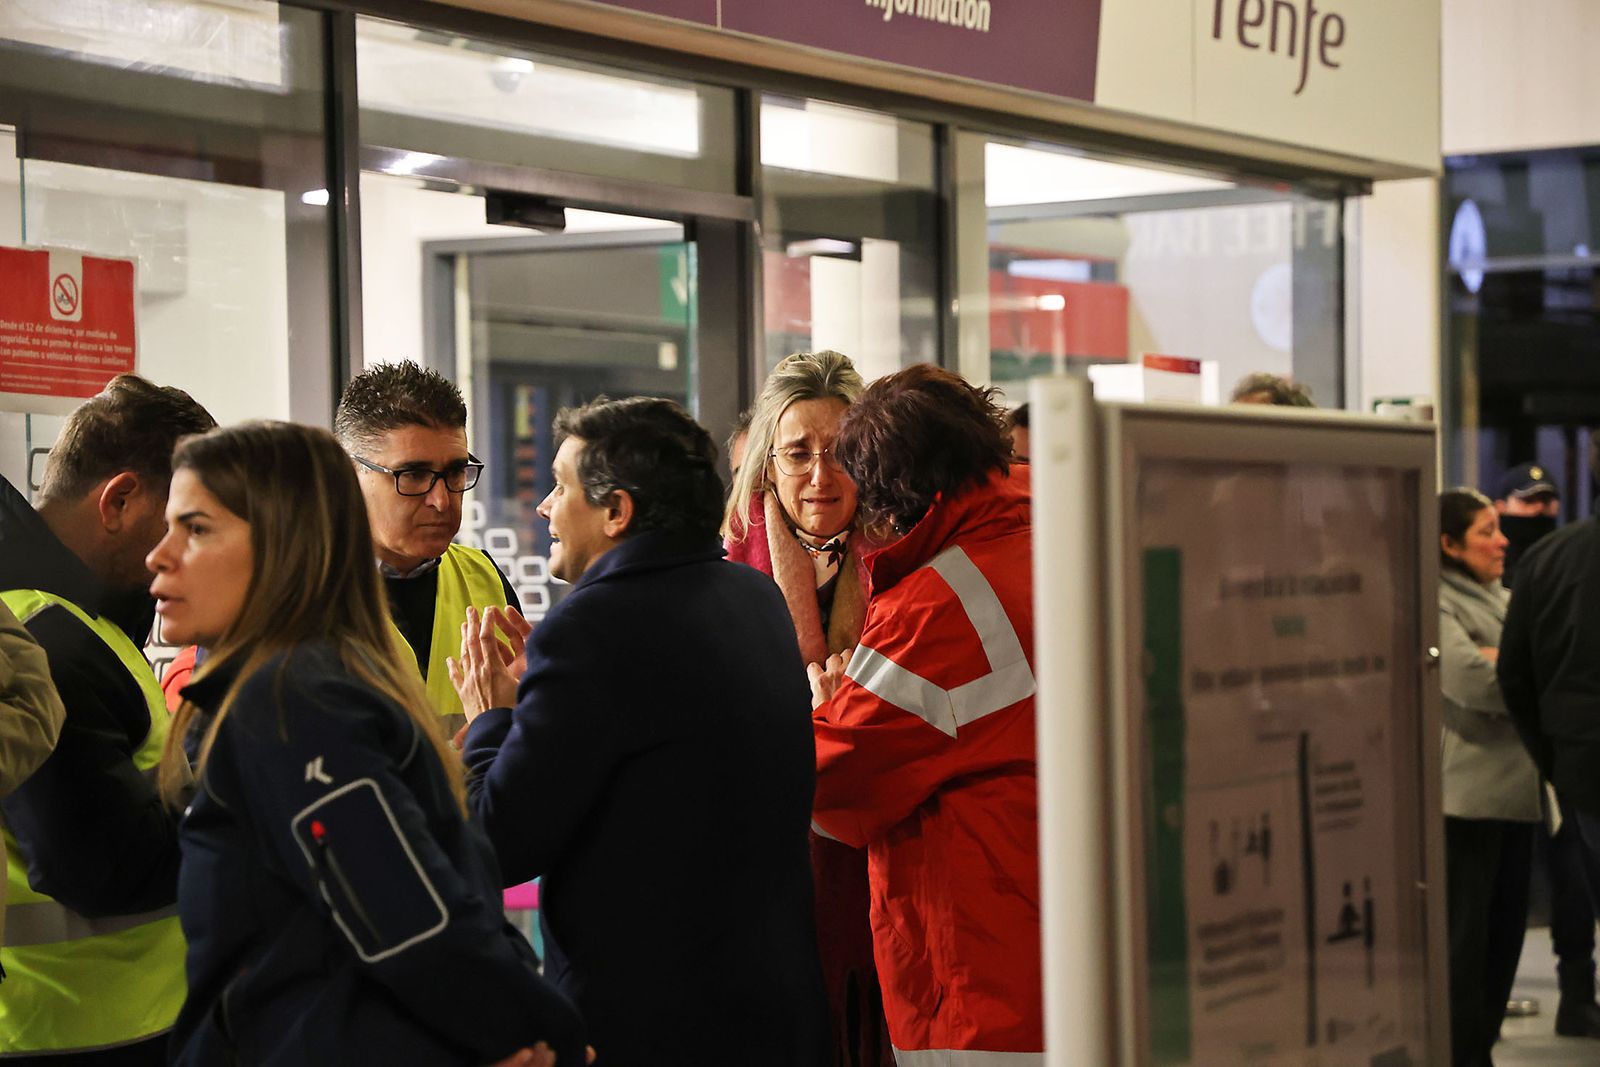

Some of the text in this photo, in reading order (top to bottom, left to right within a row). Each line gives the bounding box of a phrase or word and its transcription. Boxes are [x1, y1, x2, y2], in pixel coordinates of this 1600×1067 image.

[26, 322, 34, 332] 12
[35, 322, 43, 333] de
[31, 338, 41, 346] no
[41, 338, 48, 347] se
